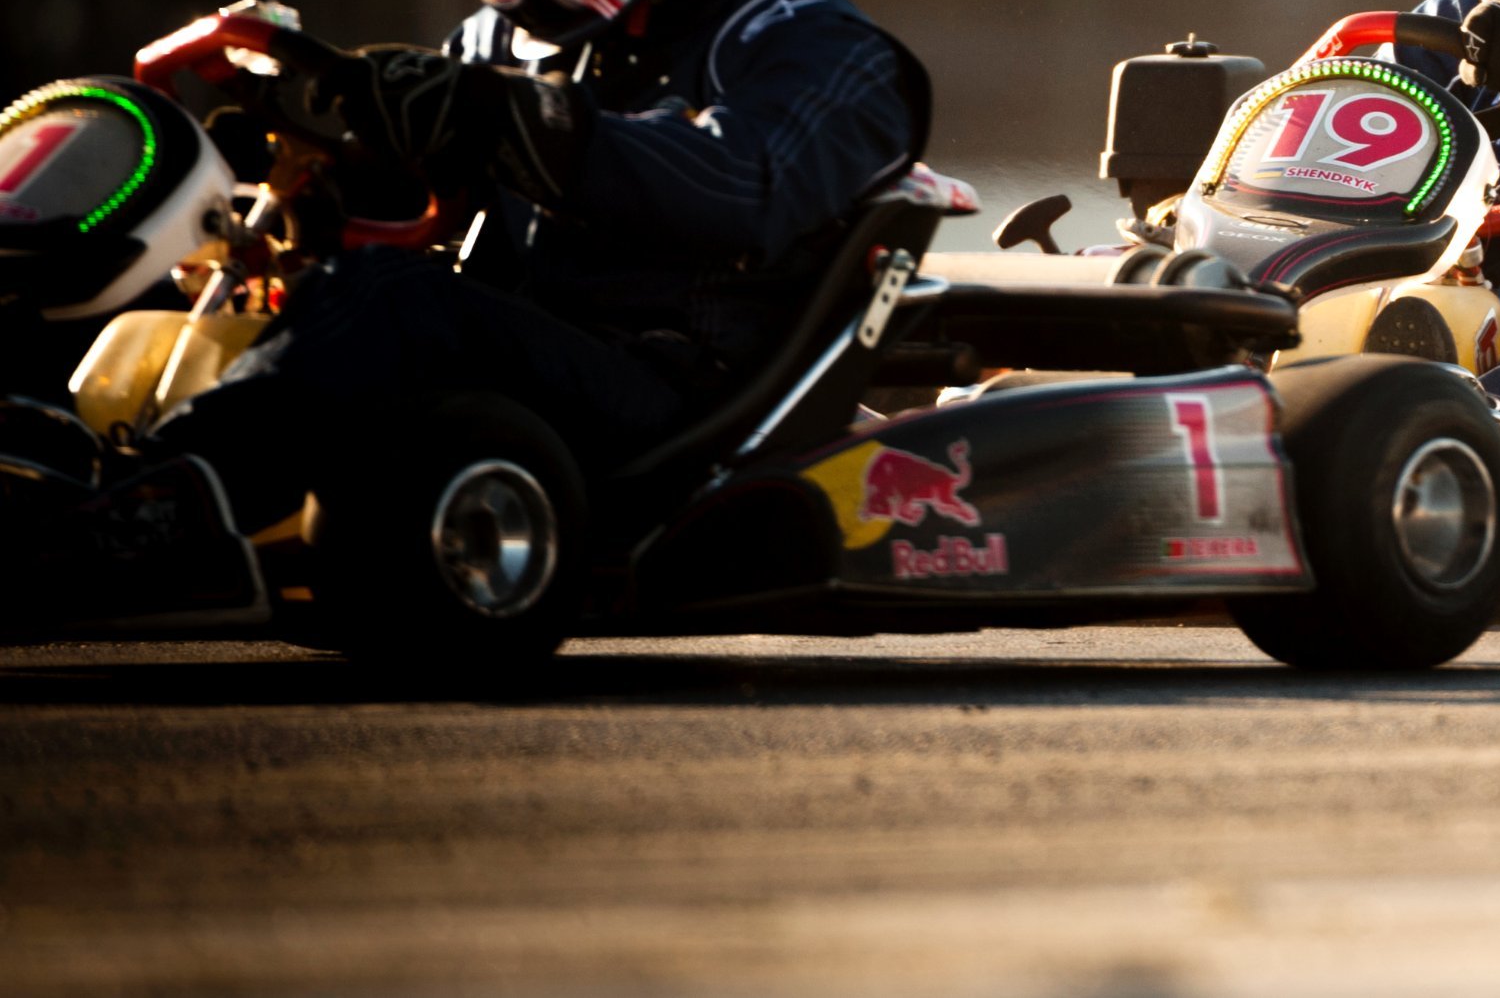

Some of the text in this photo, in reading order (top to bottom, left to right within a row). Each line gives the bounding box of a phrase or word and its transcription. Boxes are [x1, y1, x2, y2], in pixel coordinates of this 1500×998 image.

[1263, 90, 1429, 172] 19
[1286, 166, 1380, 194] SHENDRYK
[1166, 393, 1224, 525] 1
[892, 533, 1008, 579] Red Bull
